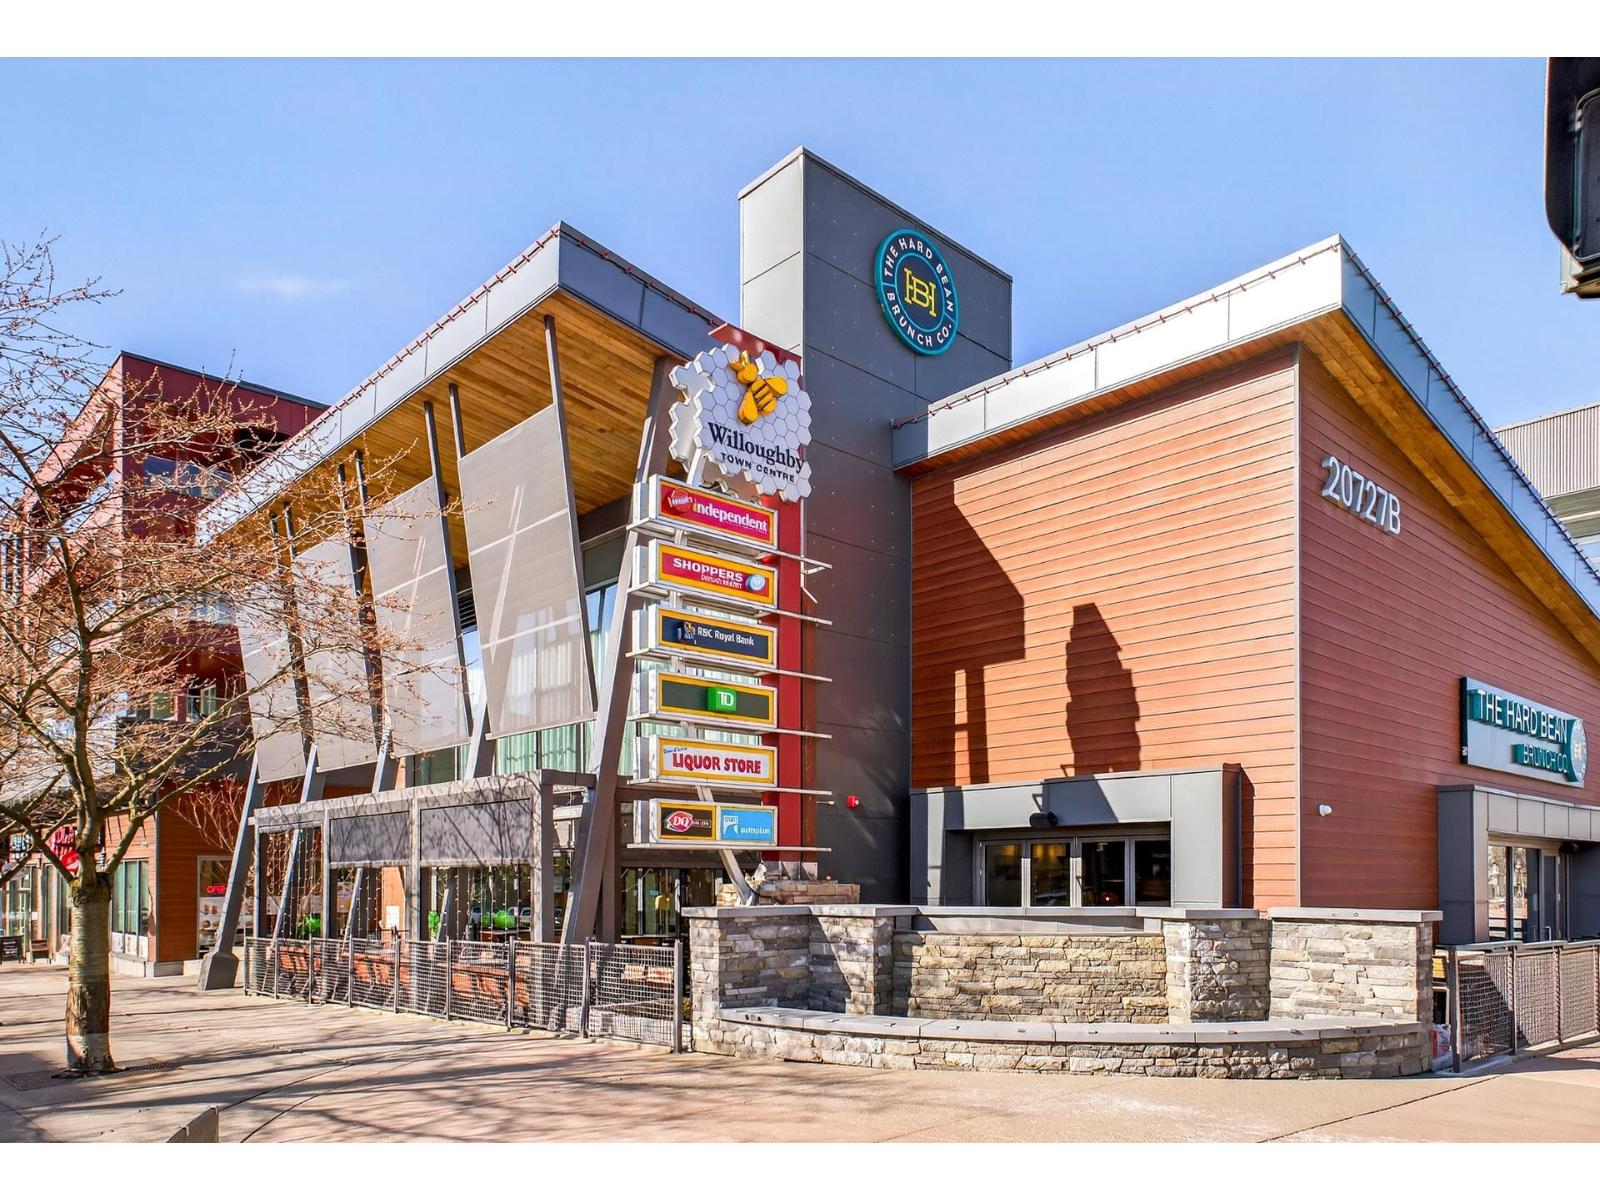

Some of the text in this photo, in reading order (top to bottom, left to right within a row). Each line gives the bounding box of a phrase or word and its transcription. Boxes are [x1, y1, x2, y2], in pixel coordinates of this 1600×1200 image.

[884, 237, 954, 312] THE HARD BEAN
[887, 292, 933, 347] BRUNCH
[708, 422, 805, 474] Willoughby
[721, 452, 795, 482] TOWN CENTRE
[1322, 456, 1401, 534] 20727B
[692, 498, 768, 531] independent
[673, 558, 743, 582] SHOPPERS
[697, 626, 713, 638] RBC
[714, 630, 735, 643] Royal
[736, 634, 754, 646] Bank
[718, 691, 734, 707] TD
[1477, 689, 1568, 744] THE HARD BEAN
[672, 753, 761, 774] LIQUOR STORE
[1523, 743, 1556, 771] BRUNCH
[673, 816, 689, 828] DQ
